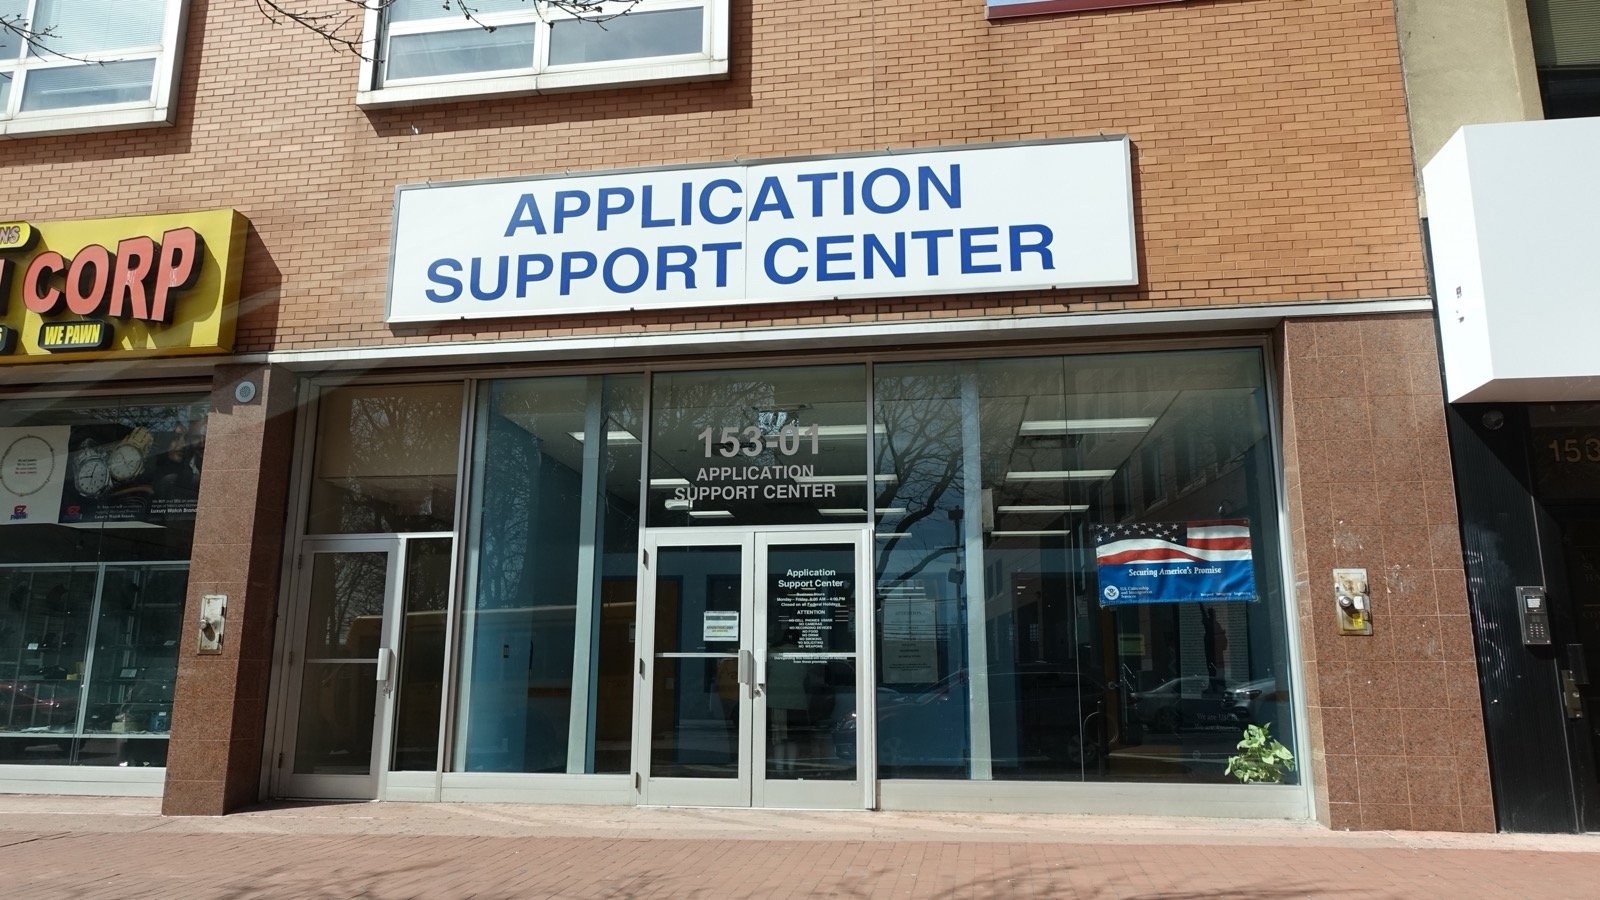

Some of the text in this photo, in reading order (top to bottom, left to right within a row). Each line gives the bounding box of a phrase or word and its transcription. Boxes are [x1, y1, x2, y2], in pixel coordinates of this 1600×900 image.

[504, 164, 962, 237] APPLICATION
[425, 223, 1056, 303] SUPPORT CENTER
[22, 226, 197, 322] CORP
[44, 324, 101, 345] WE PAWN
[698, 424, 819, 458] 153-01
[696, 464, 814, 481] APPLICATION
[674, 483, 836, 501] SUPPORT CENTER
[786, 568, 836, 578] Application
[1128, 565, 1222, 577] Securing America's Promise
[778, 579, 844, 589] Support Center
